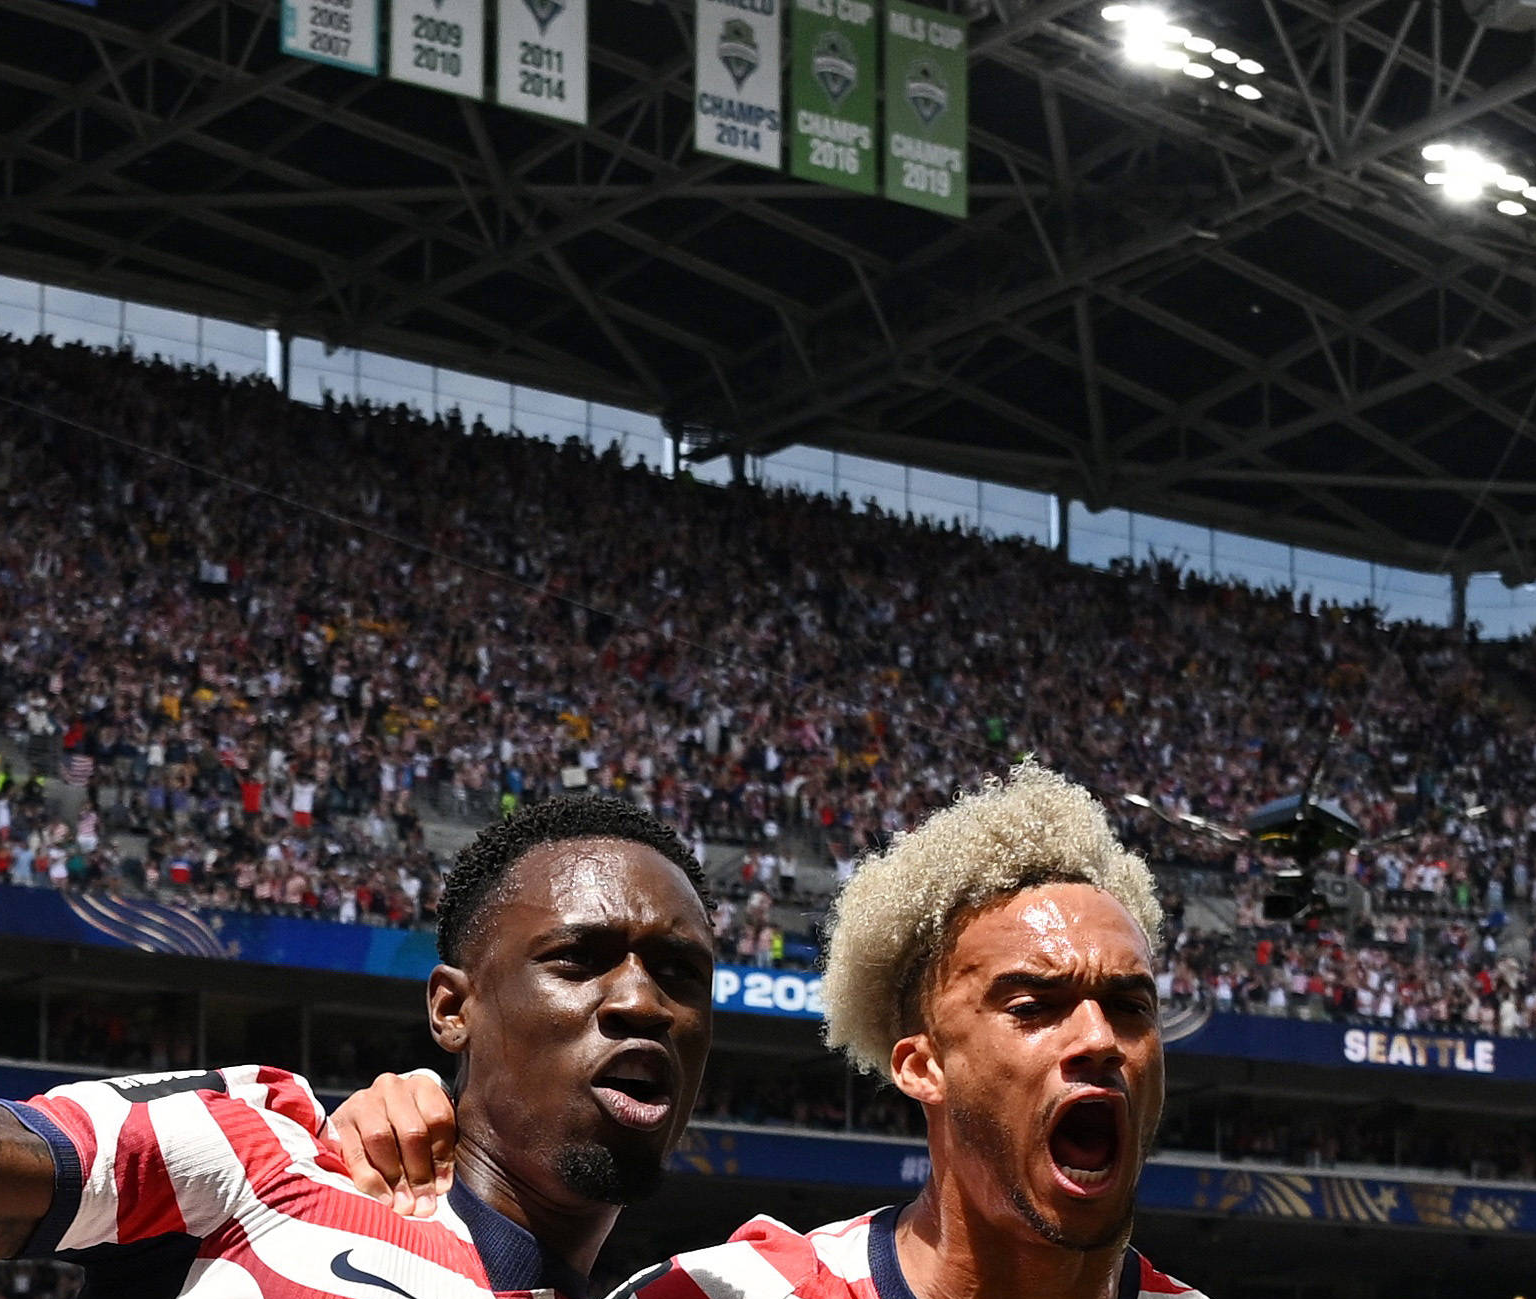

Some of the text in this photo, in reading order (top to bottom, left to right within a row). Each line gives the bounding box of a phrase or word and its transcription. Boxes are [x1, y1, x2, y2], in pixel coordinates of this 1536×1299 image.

[413, 15, 463, 48] 2009
[888, 11, 964, 50] MLS CUP
[413, 44, 462, 77] 2010
[519, 41, 564, 73] 2011
[519, 70, 566, 102] 2014
[698, 93, 779, 131] CHAMPS
[796, 109, 872, 150] CHAMPS
[716, 123, 760, 150] 2014
[890, 133, 963, 173] CHAMPS
[809, 137, 860, 176] 2016
[902, 160, 952, 198] 2019
[744, 972, 823, 1013] 202
[1344, 1028, 1496, 1074] SEATTLE
